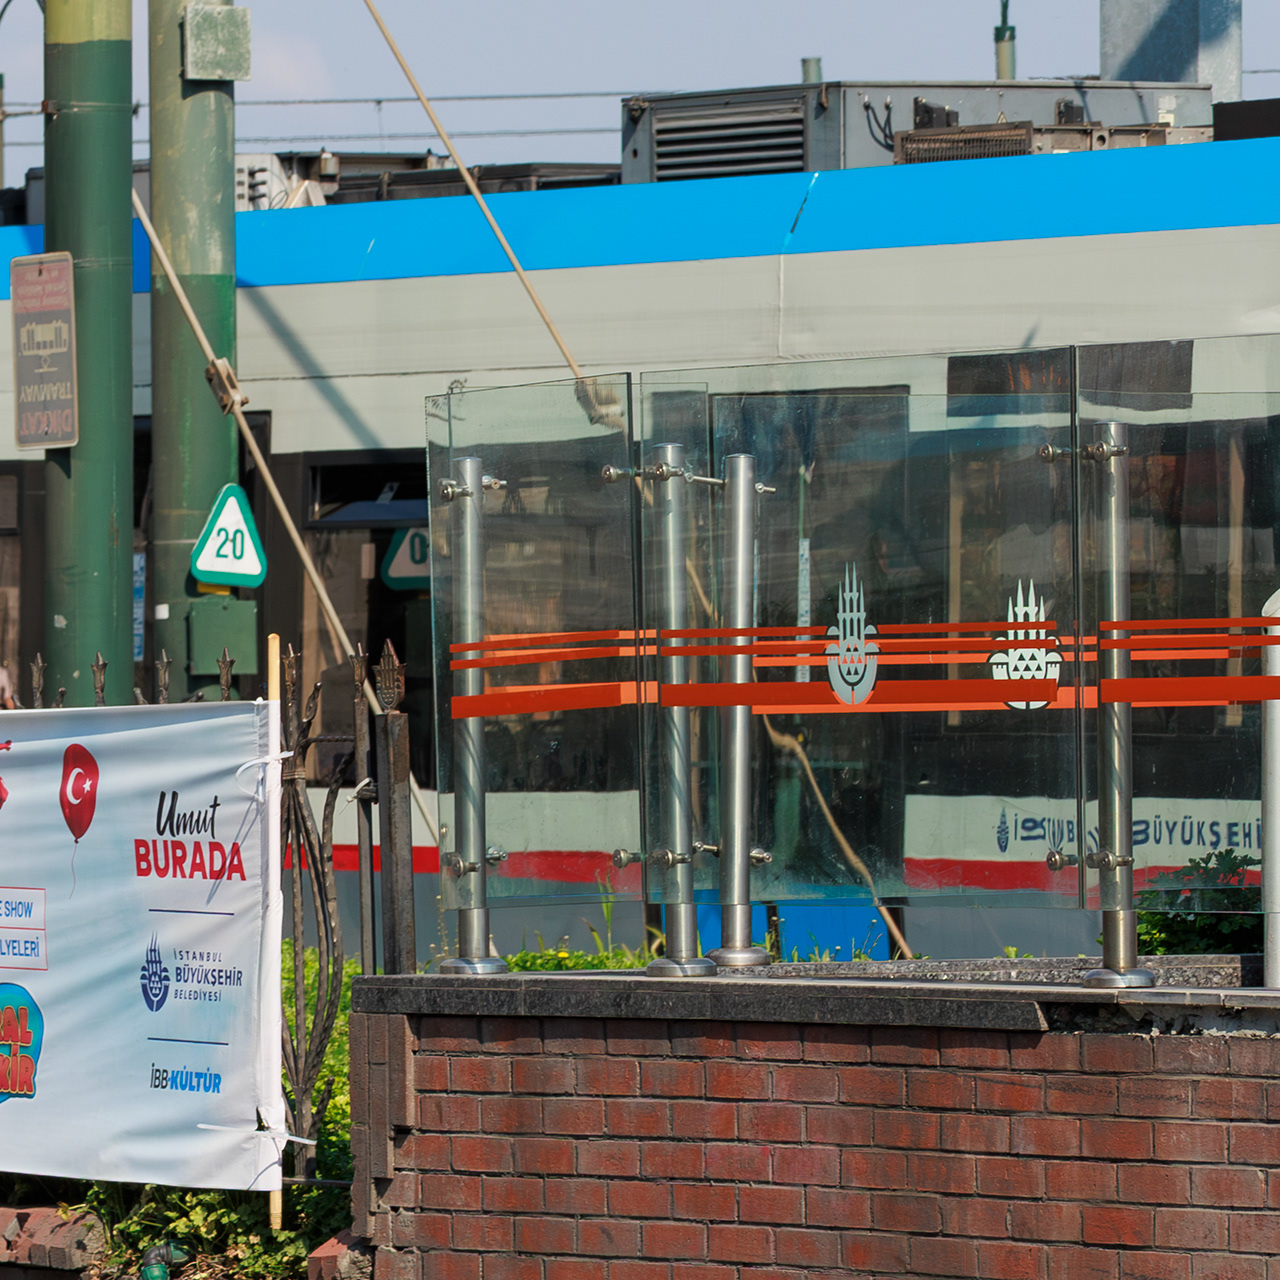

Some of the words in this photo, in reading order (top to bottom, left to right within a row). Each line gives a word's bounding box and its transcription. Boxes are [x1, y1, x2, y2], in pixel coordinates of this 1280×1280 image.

[215, 527, 245, 560] 20
[156, 790, 221, 839] Umut
[1132, 814, 1262, 850] BÜYÜKŞEHİ
[134, 838, 247, 881] BURADA
[4, 900, 33, 918] SHOW
[173, 948, 222, 962] İSTANBUL
[175, 964, 243, 987] BÜYÜKŞEHİR
[174, 989, 222, 1002] BELEDİYESİ
